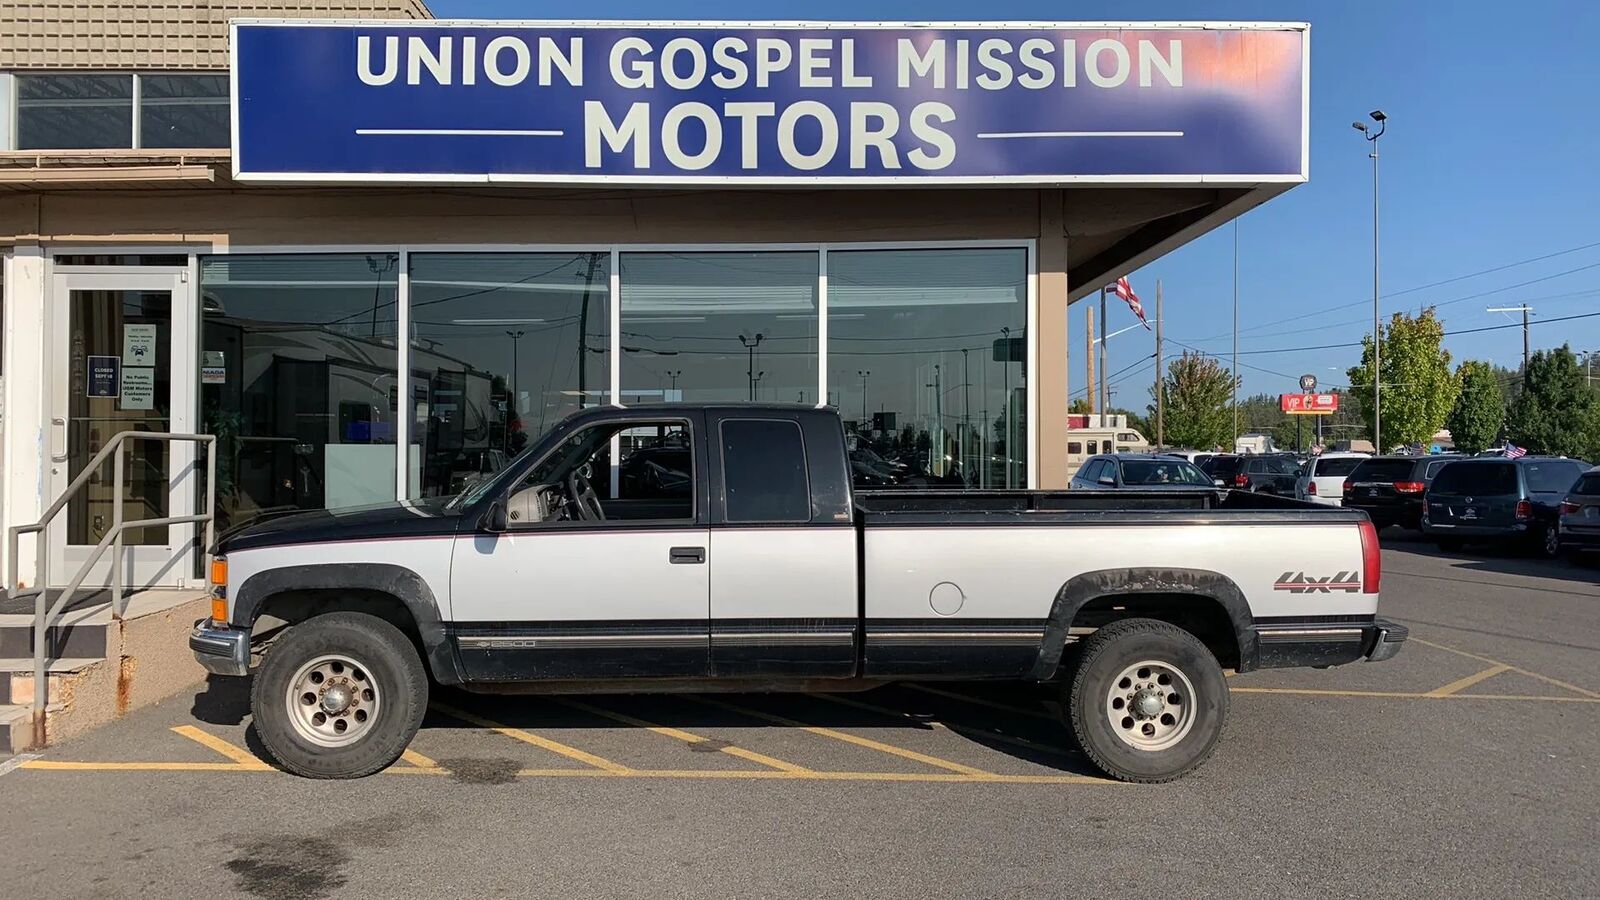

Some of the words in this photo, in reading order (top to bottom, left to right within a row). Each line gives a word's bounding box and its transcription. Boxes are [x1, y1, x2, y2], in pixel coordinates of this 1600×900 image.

[357, 35, 583, 86] UNION
[609, 37, 873, 90] GOSPEL
[897, 38, 1183, 90] MISSION
[584, 100, 957, 170] MOTORS
[1273, 571, 1361, 594] 4x4
